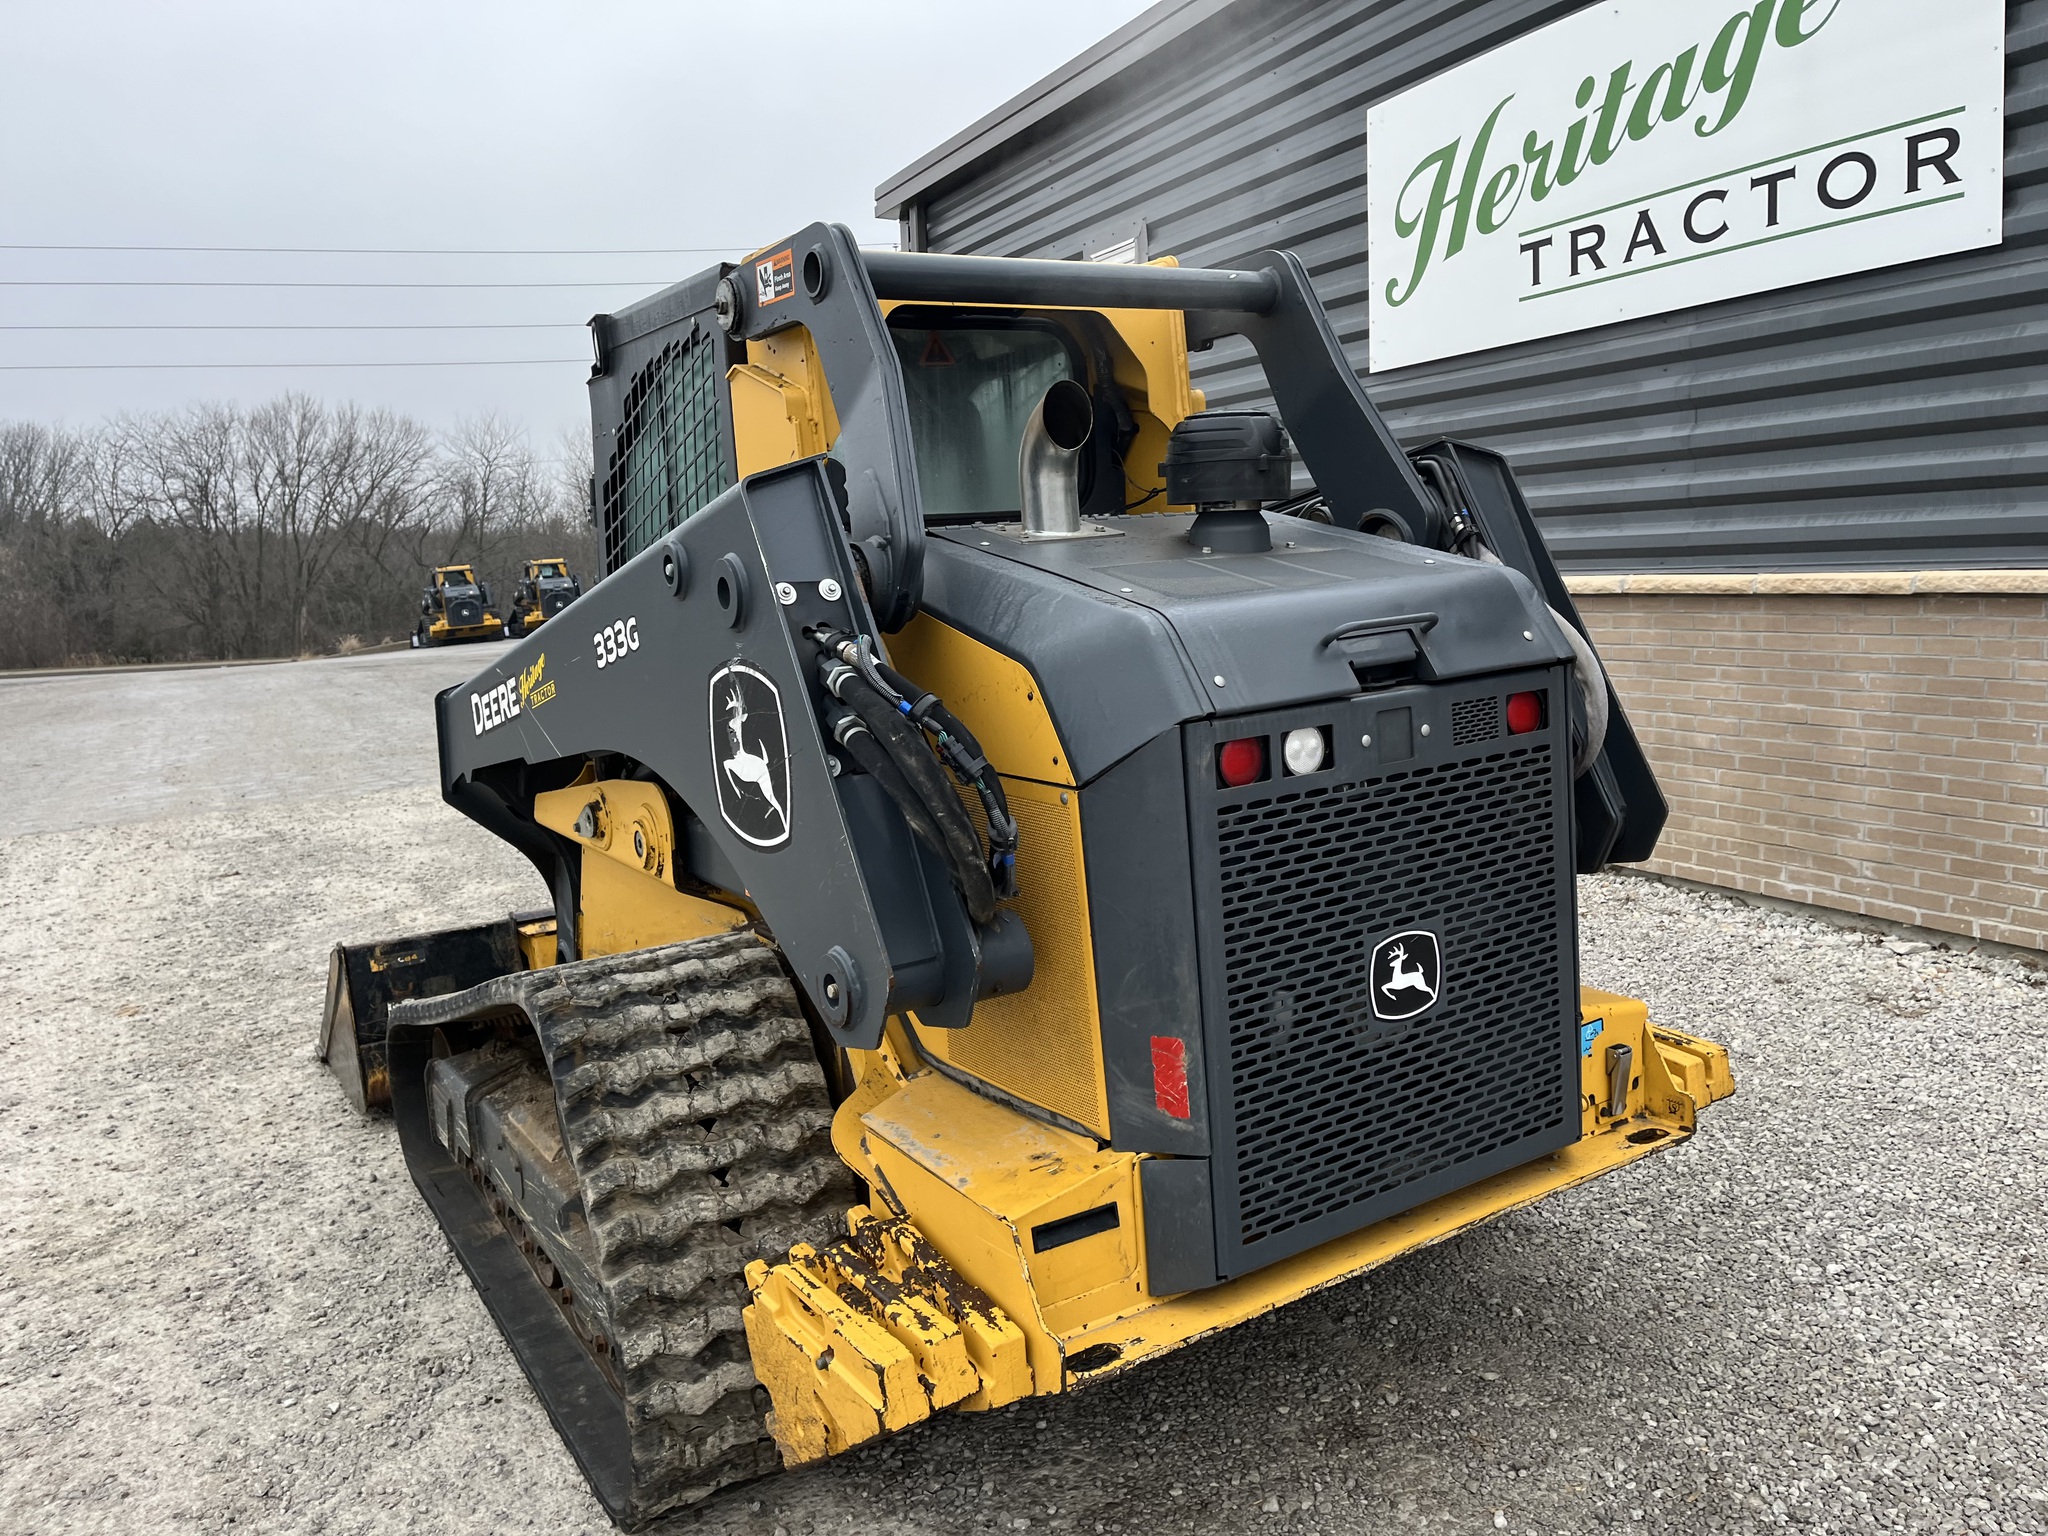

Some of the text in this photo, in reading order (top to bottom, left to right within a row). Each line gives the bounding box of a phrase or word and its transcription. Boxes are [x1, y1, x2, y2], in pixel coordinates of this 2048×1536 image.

[1520, 127, 1963, 287] TRACTOR
[593, 616, 640, 669] 333G
[470, 676, 521, 736] DEERE
[530, 683, 556, 706] TRACTOR
